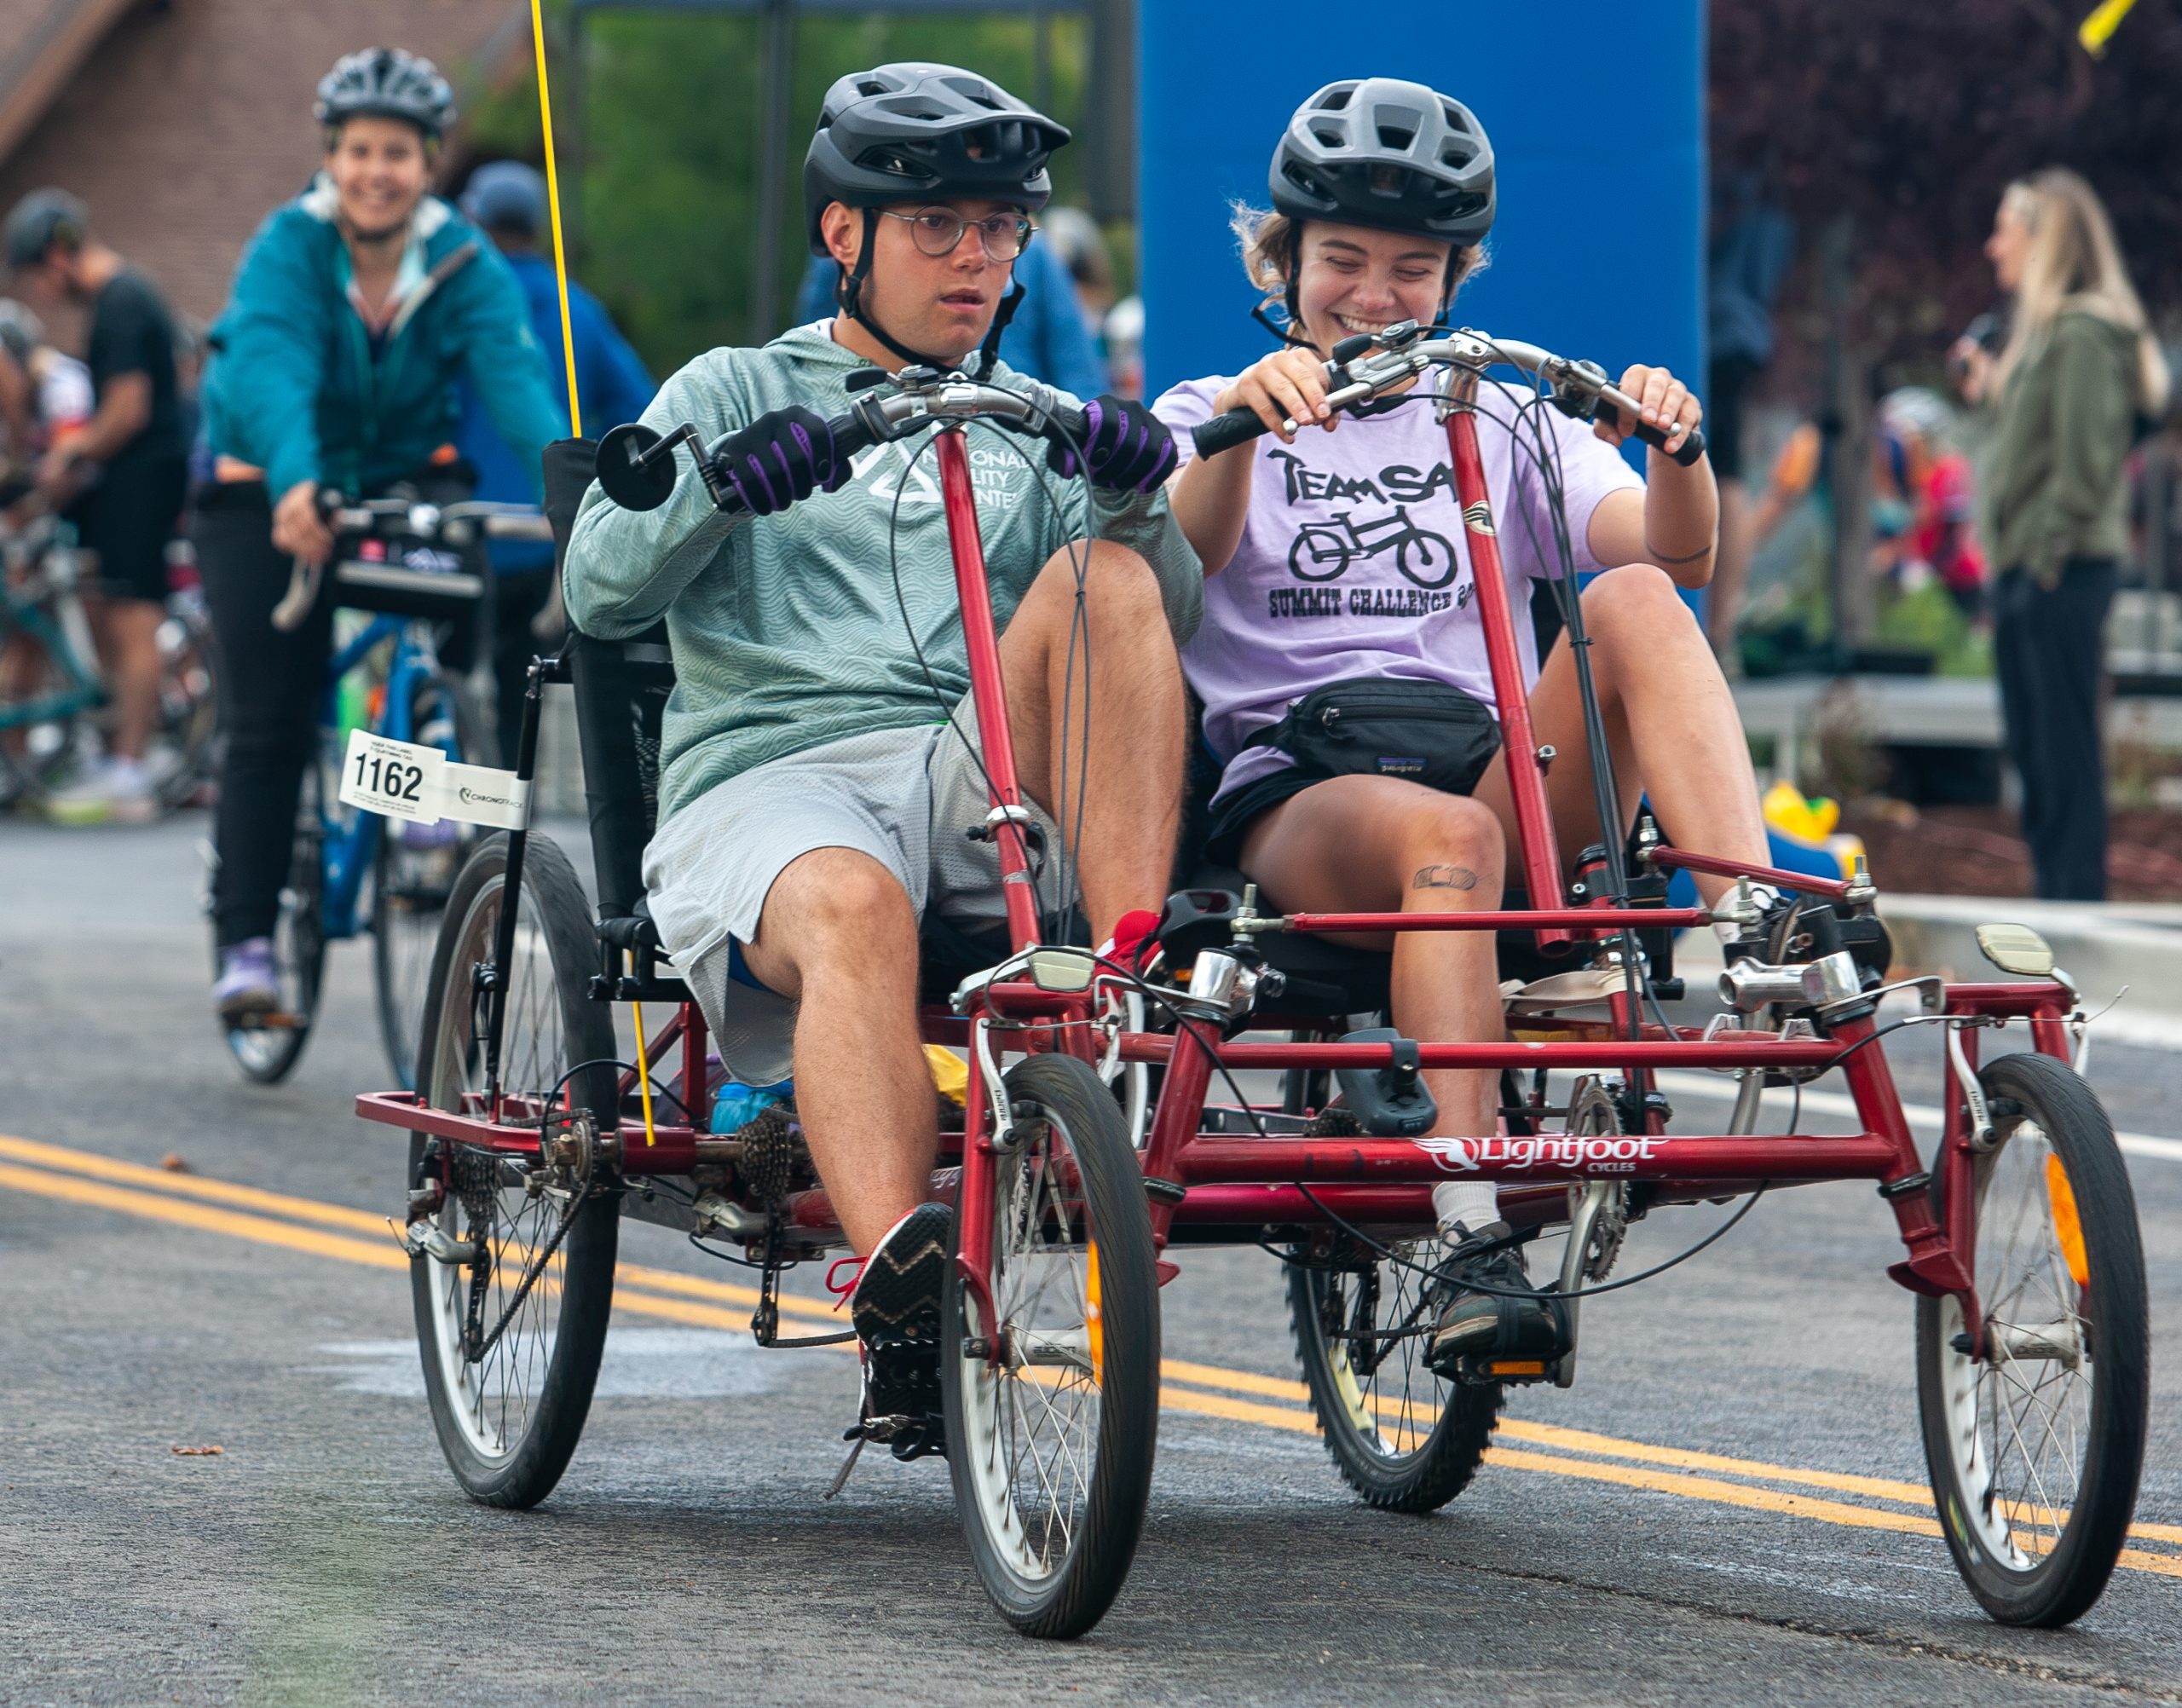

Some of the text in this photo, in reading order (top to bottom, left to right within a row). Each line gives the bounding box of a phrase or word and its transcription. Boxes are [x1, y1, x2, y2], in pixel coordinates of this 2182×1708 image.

[922, 448, 1030, 468] NONAL
[1267, 448, 1458, 506] TEAM SA
[1269, 588, 1341, 617] SUMMIT
[1349, 588, 1451, 617] CHALLENGE
[355, 753, 423, 801] 1162
[1481, 1135, 1669, 1168] Lightfoot
[1587, 1162, 1636, 1172] CYCLES
